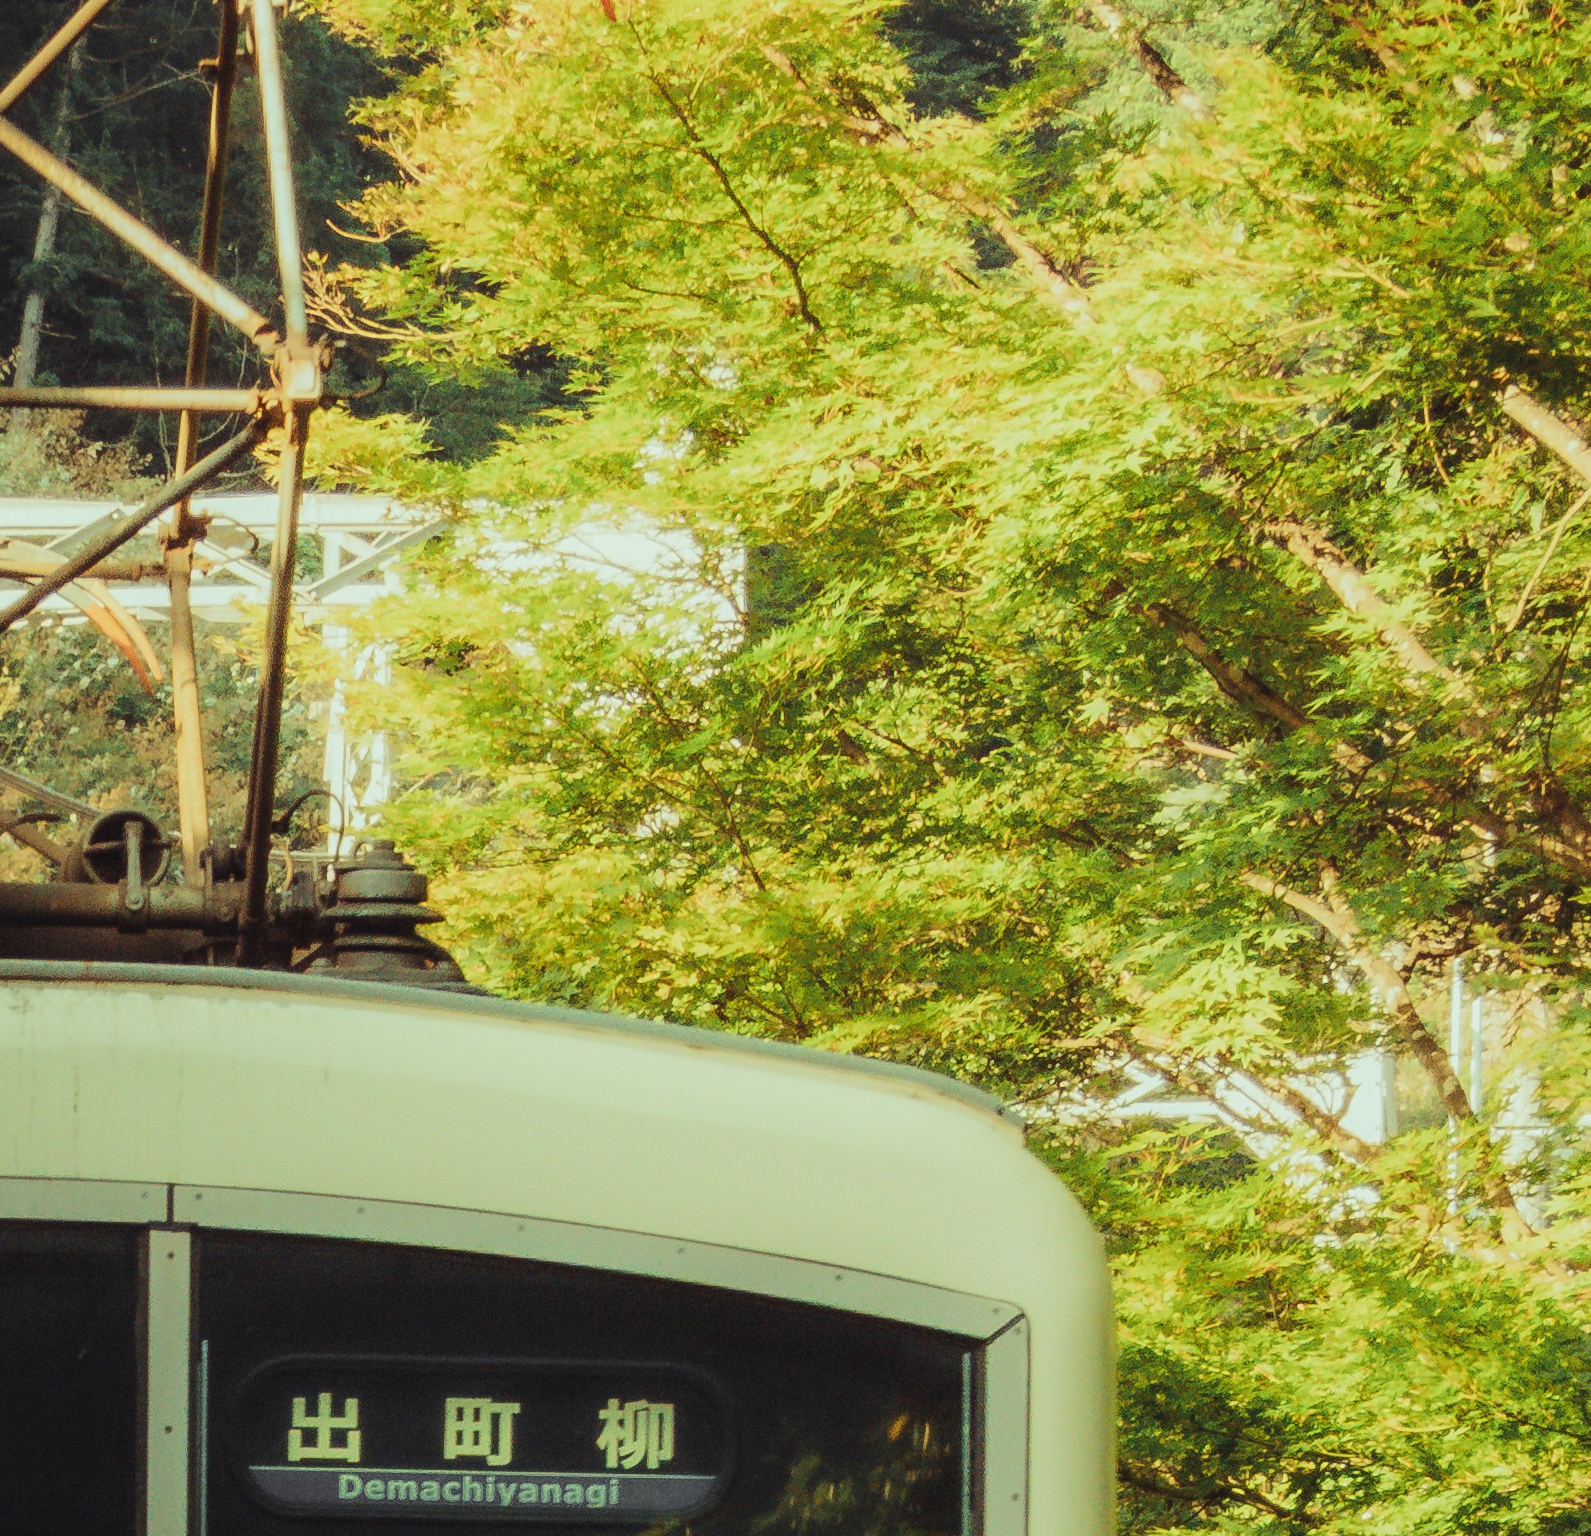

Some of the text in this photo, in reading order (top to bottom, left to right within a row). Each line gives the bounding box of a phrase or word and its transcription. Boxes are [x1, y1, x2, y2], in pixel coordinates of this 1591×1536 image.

[287, 1392, 675, 1470] 出町柳
[338, 1474, 620, 1508] Demachiyanagi
